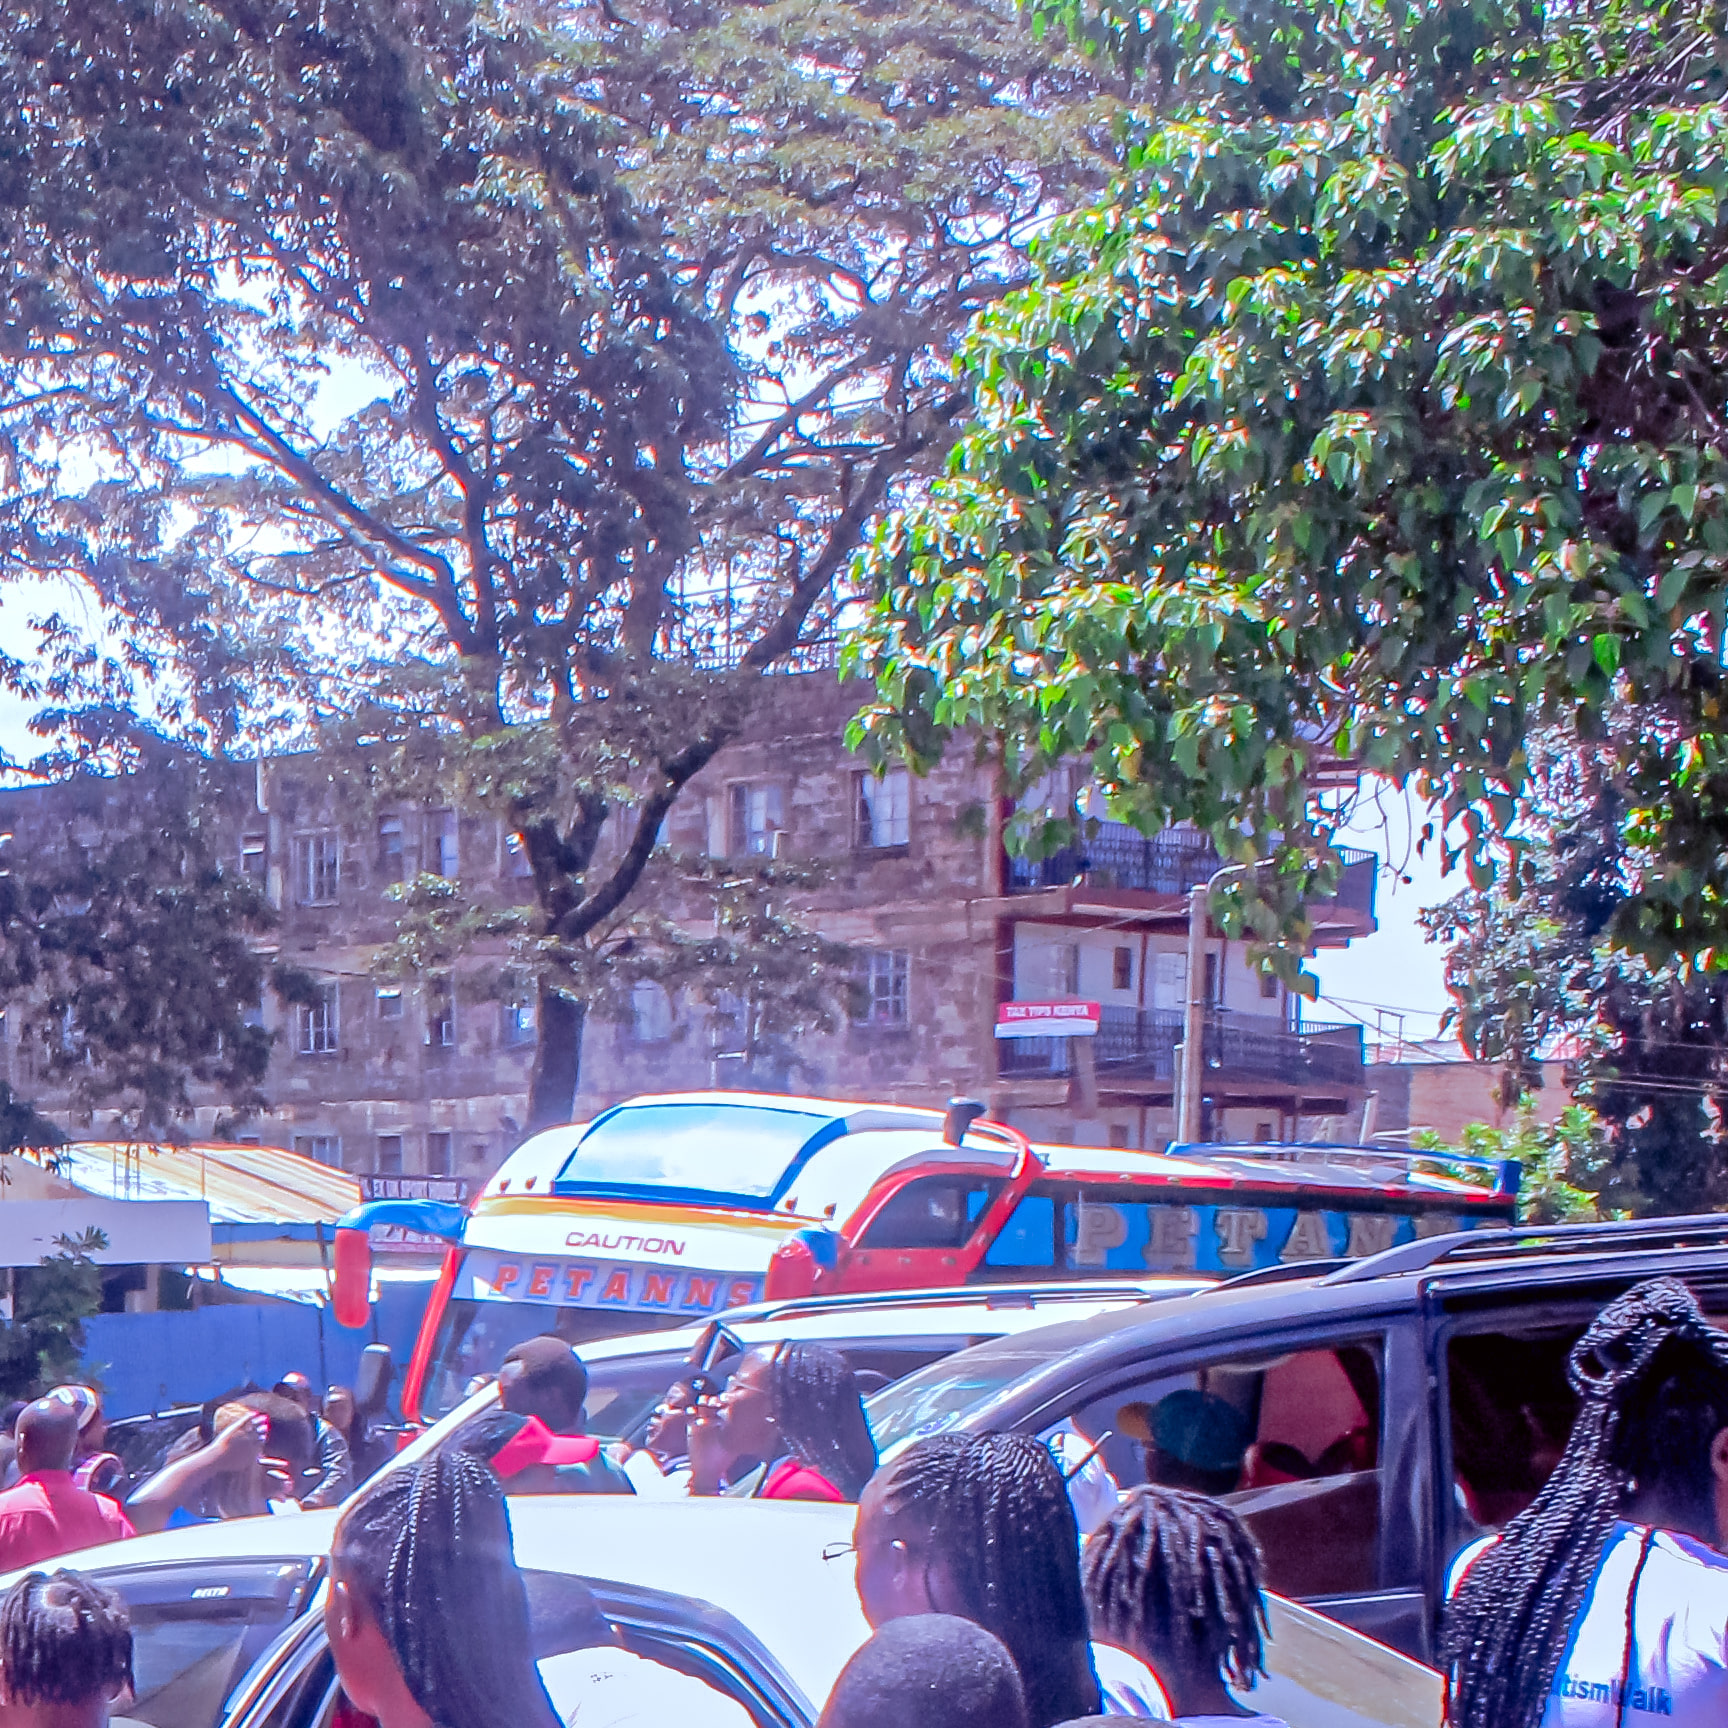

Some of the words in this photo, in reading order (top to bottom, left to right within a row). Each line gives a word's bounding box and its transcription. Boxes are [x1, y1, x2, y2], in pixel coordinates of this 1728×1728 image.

[565, 1231, 686, 1255] CAUTION
[1074, 1203, 1512, 1266] PETAN
[491, 1263, 758, 1309] PETANNS
